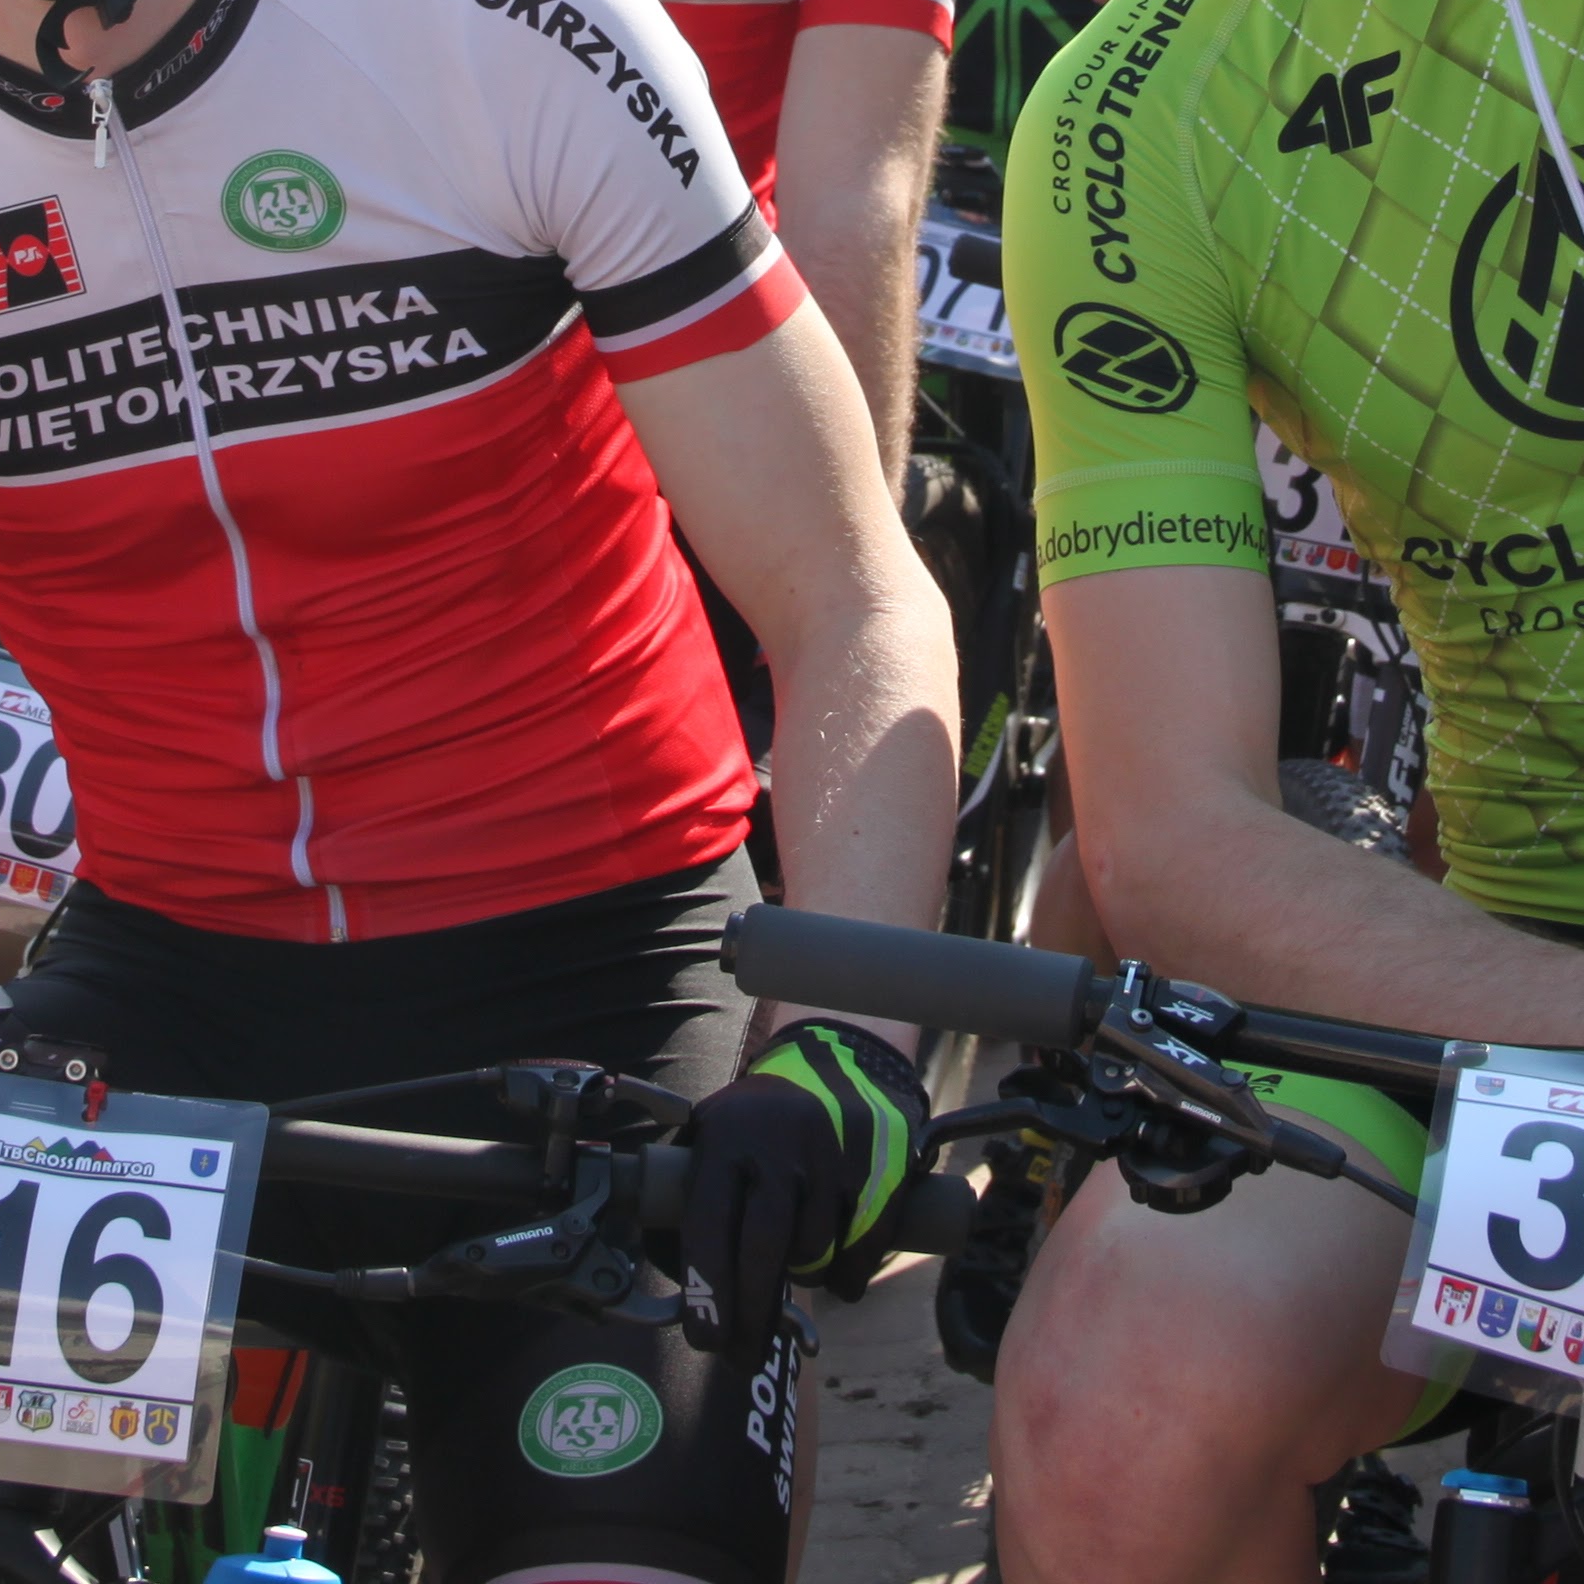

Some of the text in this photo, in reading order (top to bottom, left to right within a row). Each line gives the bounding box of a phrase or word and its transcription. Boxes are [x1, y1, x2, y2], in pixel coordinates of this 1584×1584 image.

[1277, 50, 1401, 155] 4F
[1052, 116, 1076, 216] CROSS
[1064, 38, 1119, 106] YOUR
[1160, 1002, 1214, 1024] XT
[1153, 1038, 1207, 1065] XT
[494, 1226, 554, 1247] SHIMANO
[684, 1265, 718, 1326] 4F
